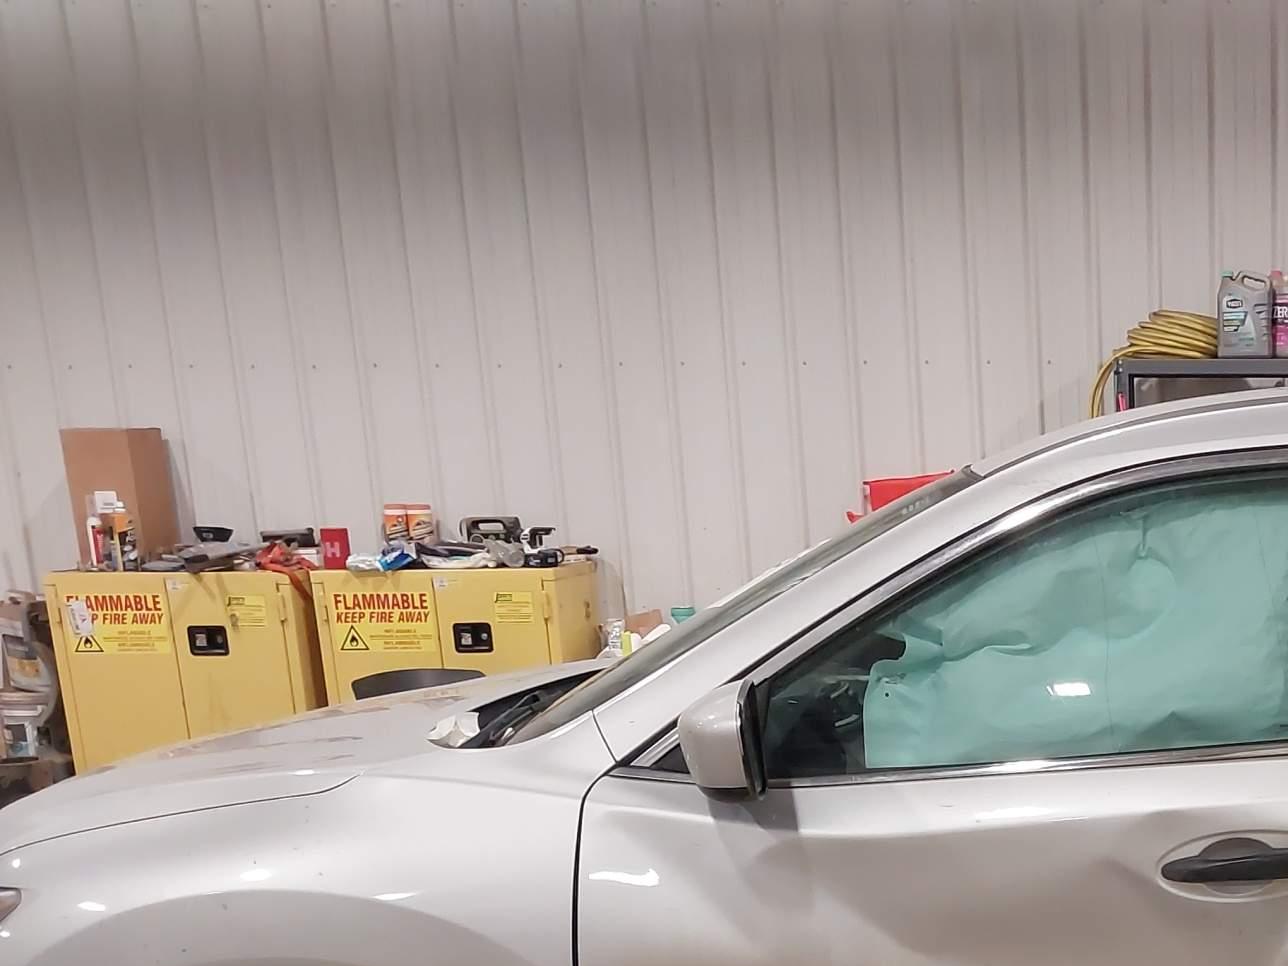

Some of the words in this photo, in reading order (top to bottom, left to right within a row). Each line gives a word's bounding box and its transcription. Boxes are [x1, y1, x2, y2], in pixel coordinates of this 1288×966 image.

[66, 595, 162, 611] AMMABLE
[333, 593, 429, 610] FLAMMABLE
[102, 613, 127, 625] FIRE
[131, 613, 164, 625] AWAY
[336, 611, 365, 624] KEEP
[369, 611, 394, 623] FIRE
[398, 611, 430, 623] AWAY
